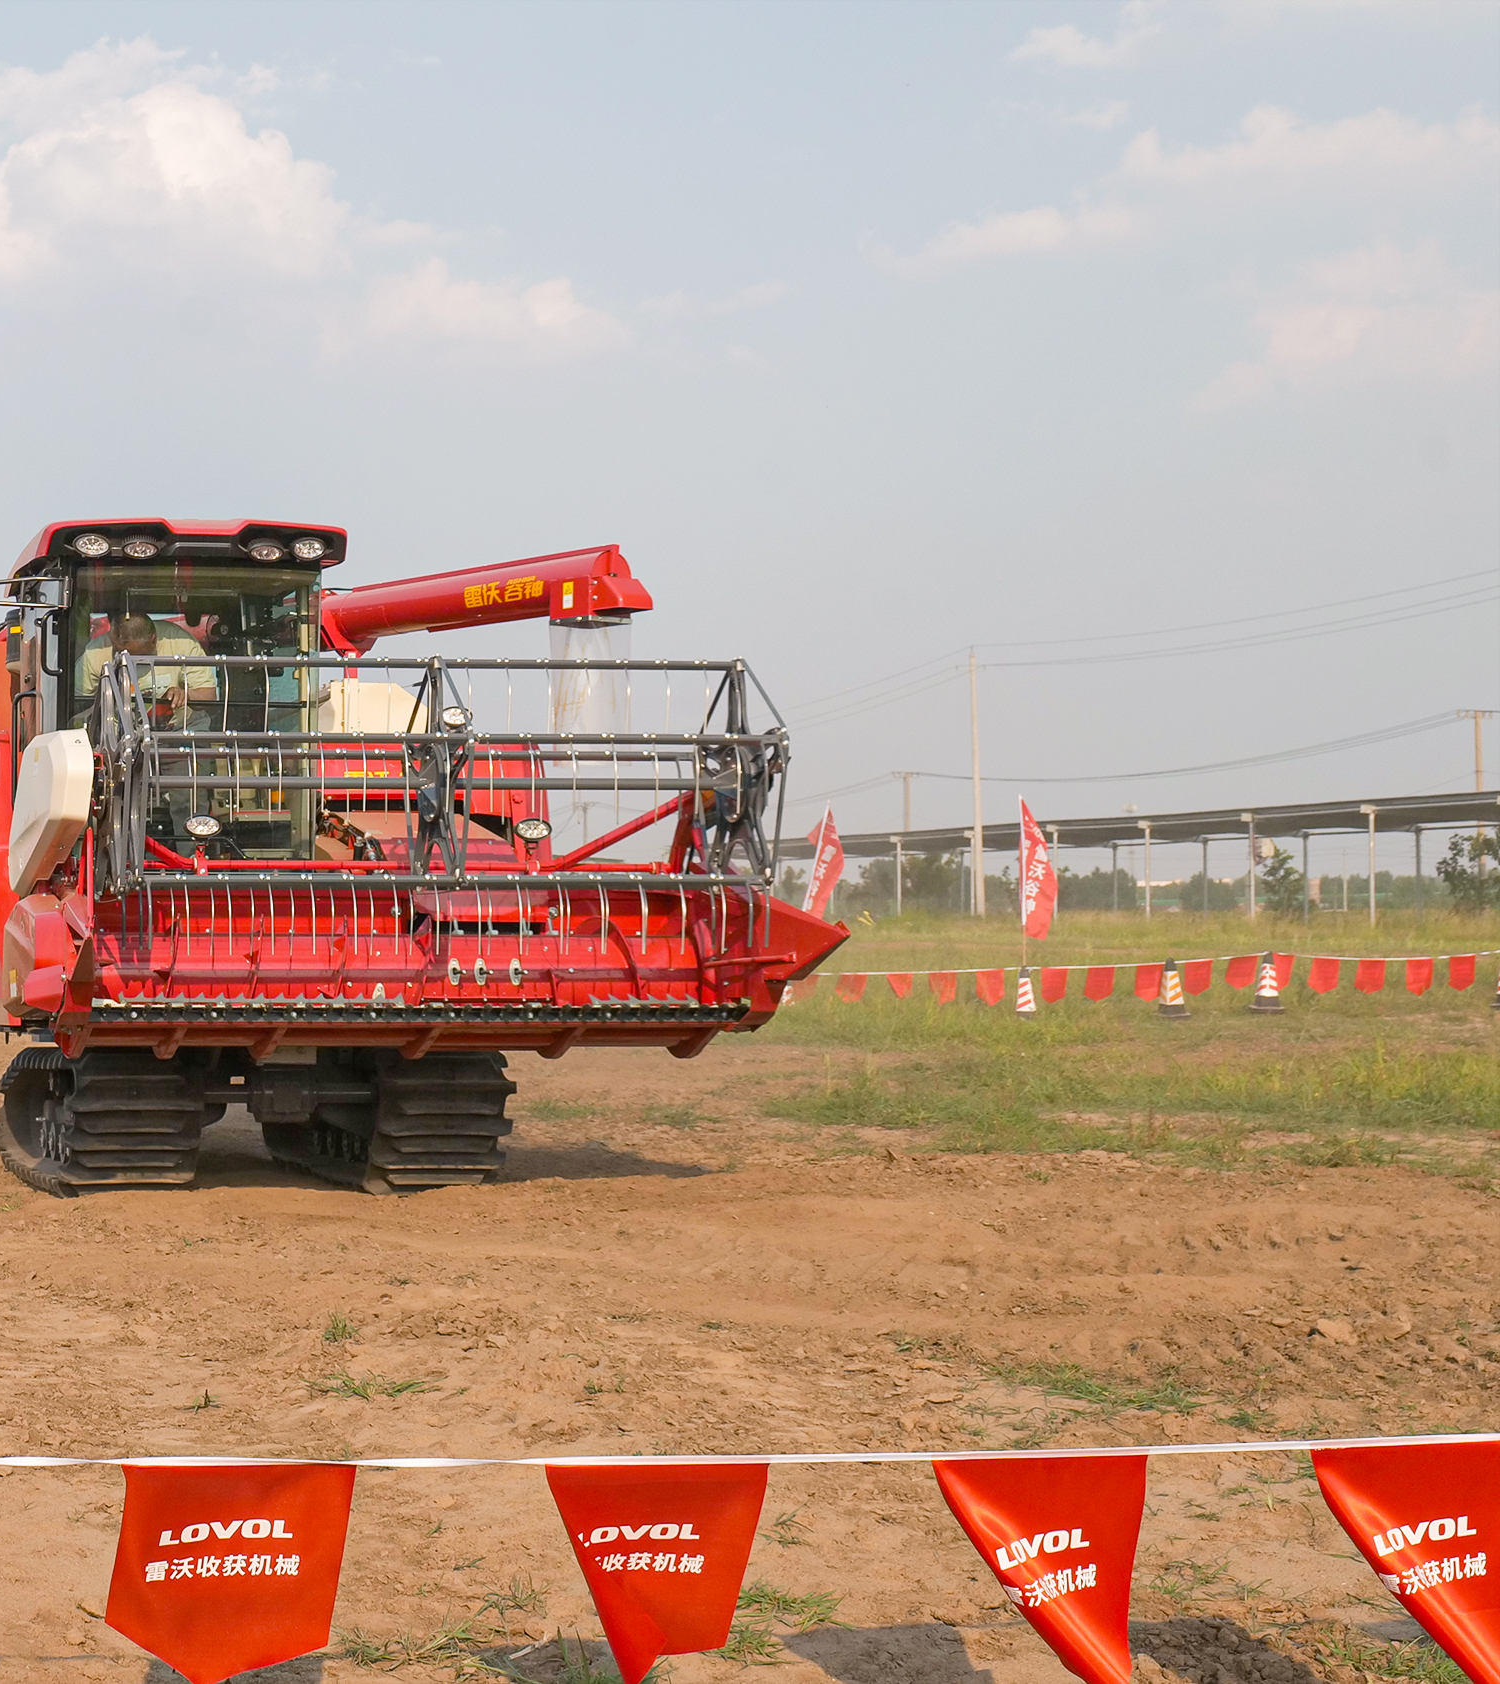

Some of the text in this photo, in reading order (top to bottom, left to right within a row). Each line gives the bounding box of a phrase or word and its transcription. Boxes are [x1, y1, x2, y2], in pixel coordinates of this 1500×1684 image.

[158, 1518, 294, 1547] LOVOL
[1373, 1515, 1477, 1557] LOVOL
[594, 1552, 705, 1574] 收获机械
[995, 1528, 1090, 1571] LOVOL
[144, 1553, 301, 1583] 雷沃收获机械
